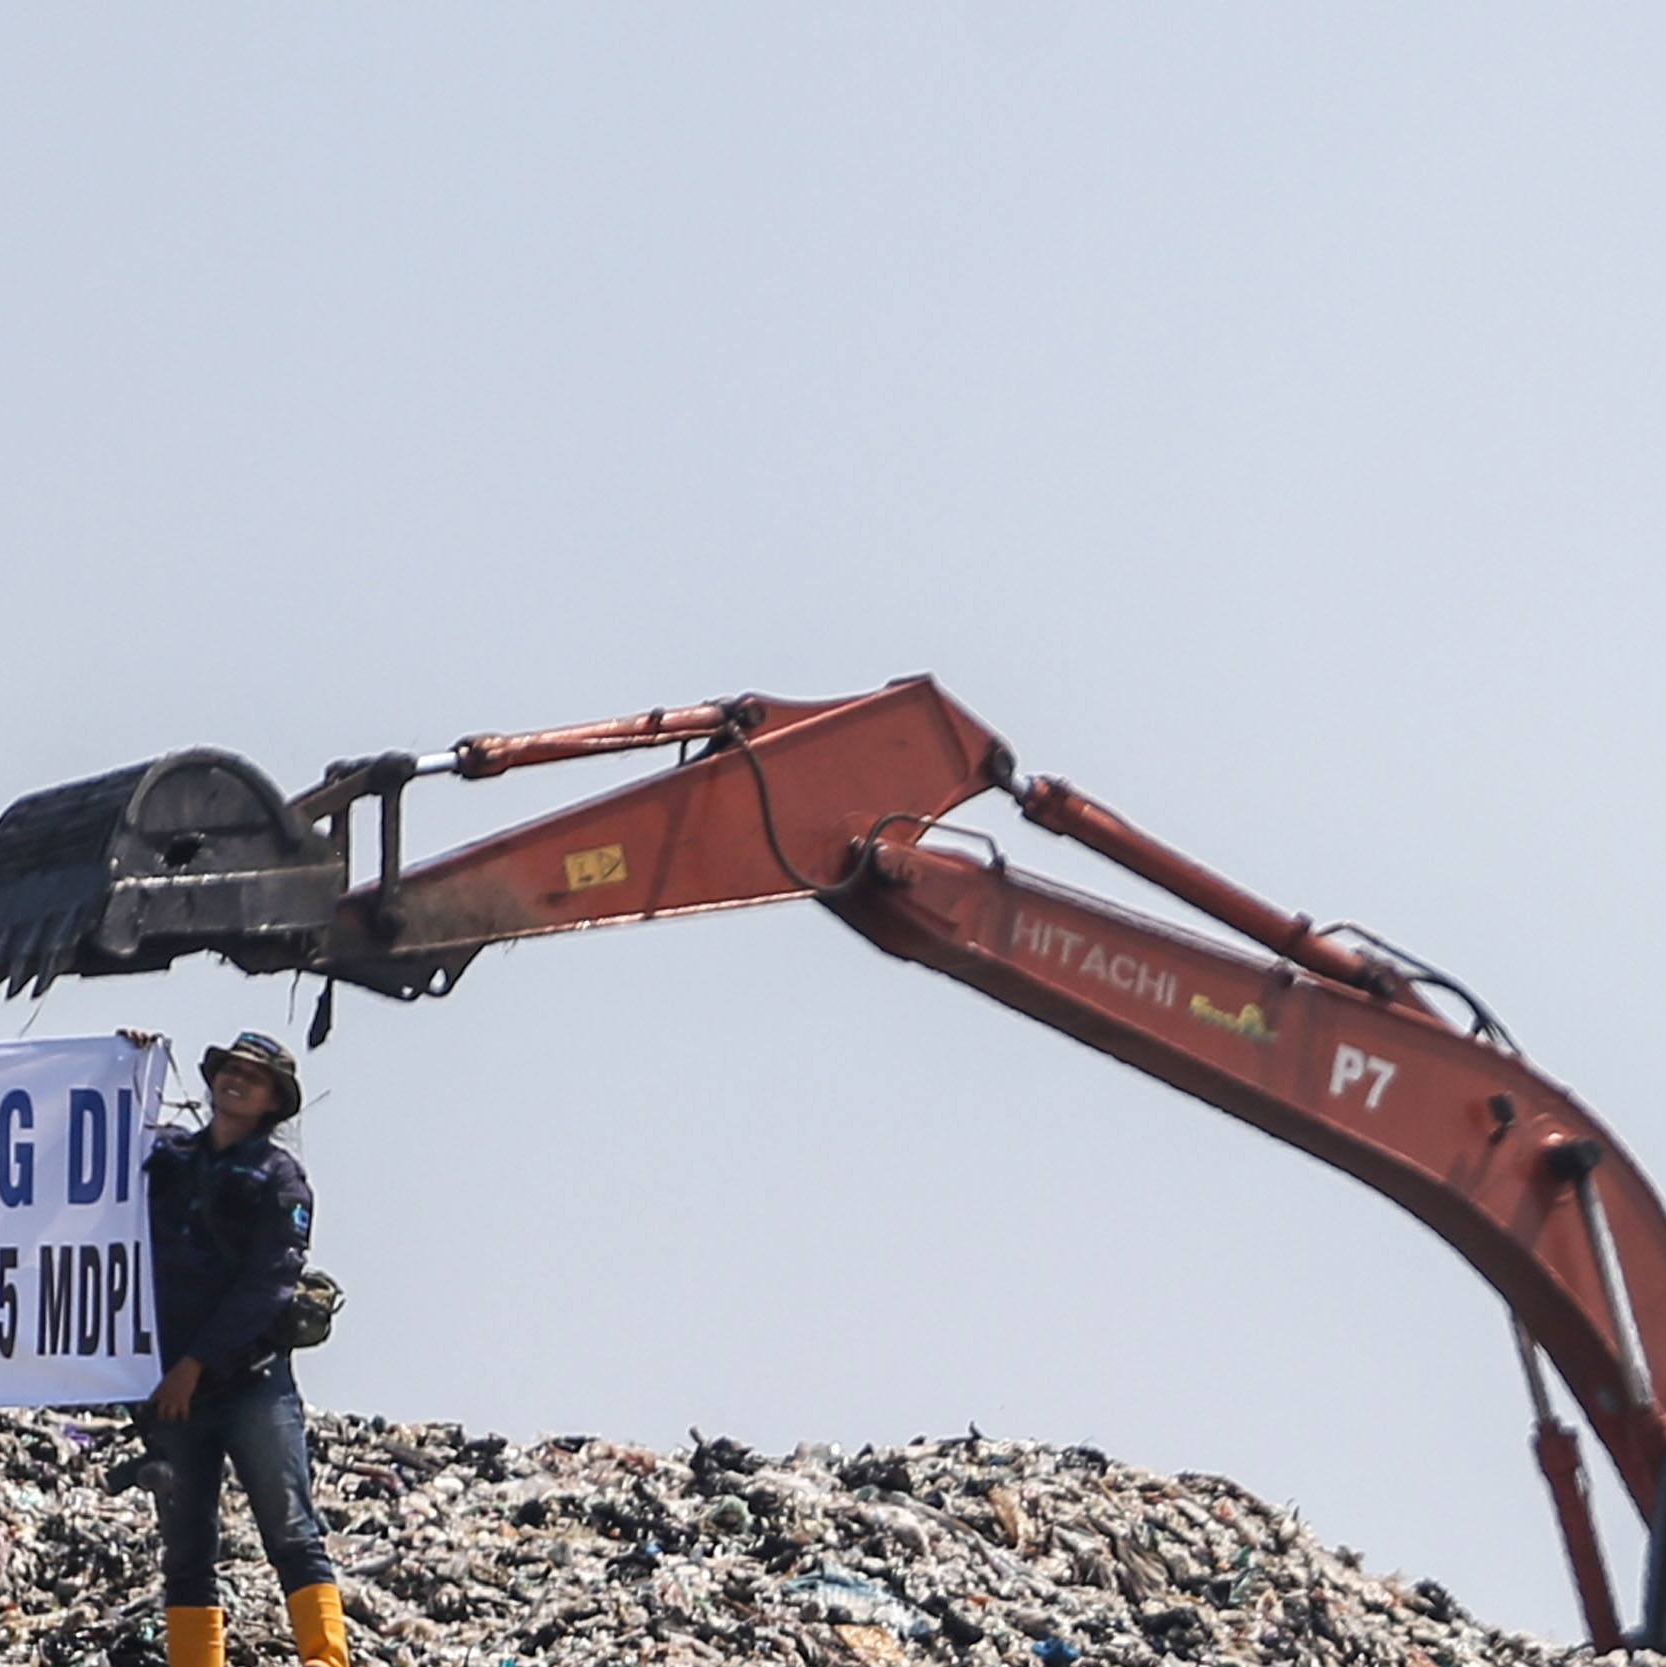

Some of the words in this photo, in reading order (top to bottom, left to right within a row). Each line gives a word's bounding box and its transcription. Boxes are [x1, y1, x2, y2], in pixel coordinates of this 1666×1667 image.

[1010, 909, 1178, 1008] HITACHI
[1329, 1042, 1397, 1109] P7
[67, 1088, 132, 1205] DI
[36, 1240, 152, 1358] MDPL
